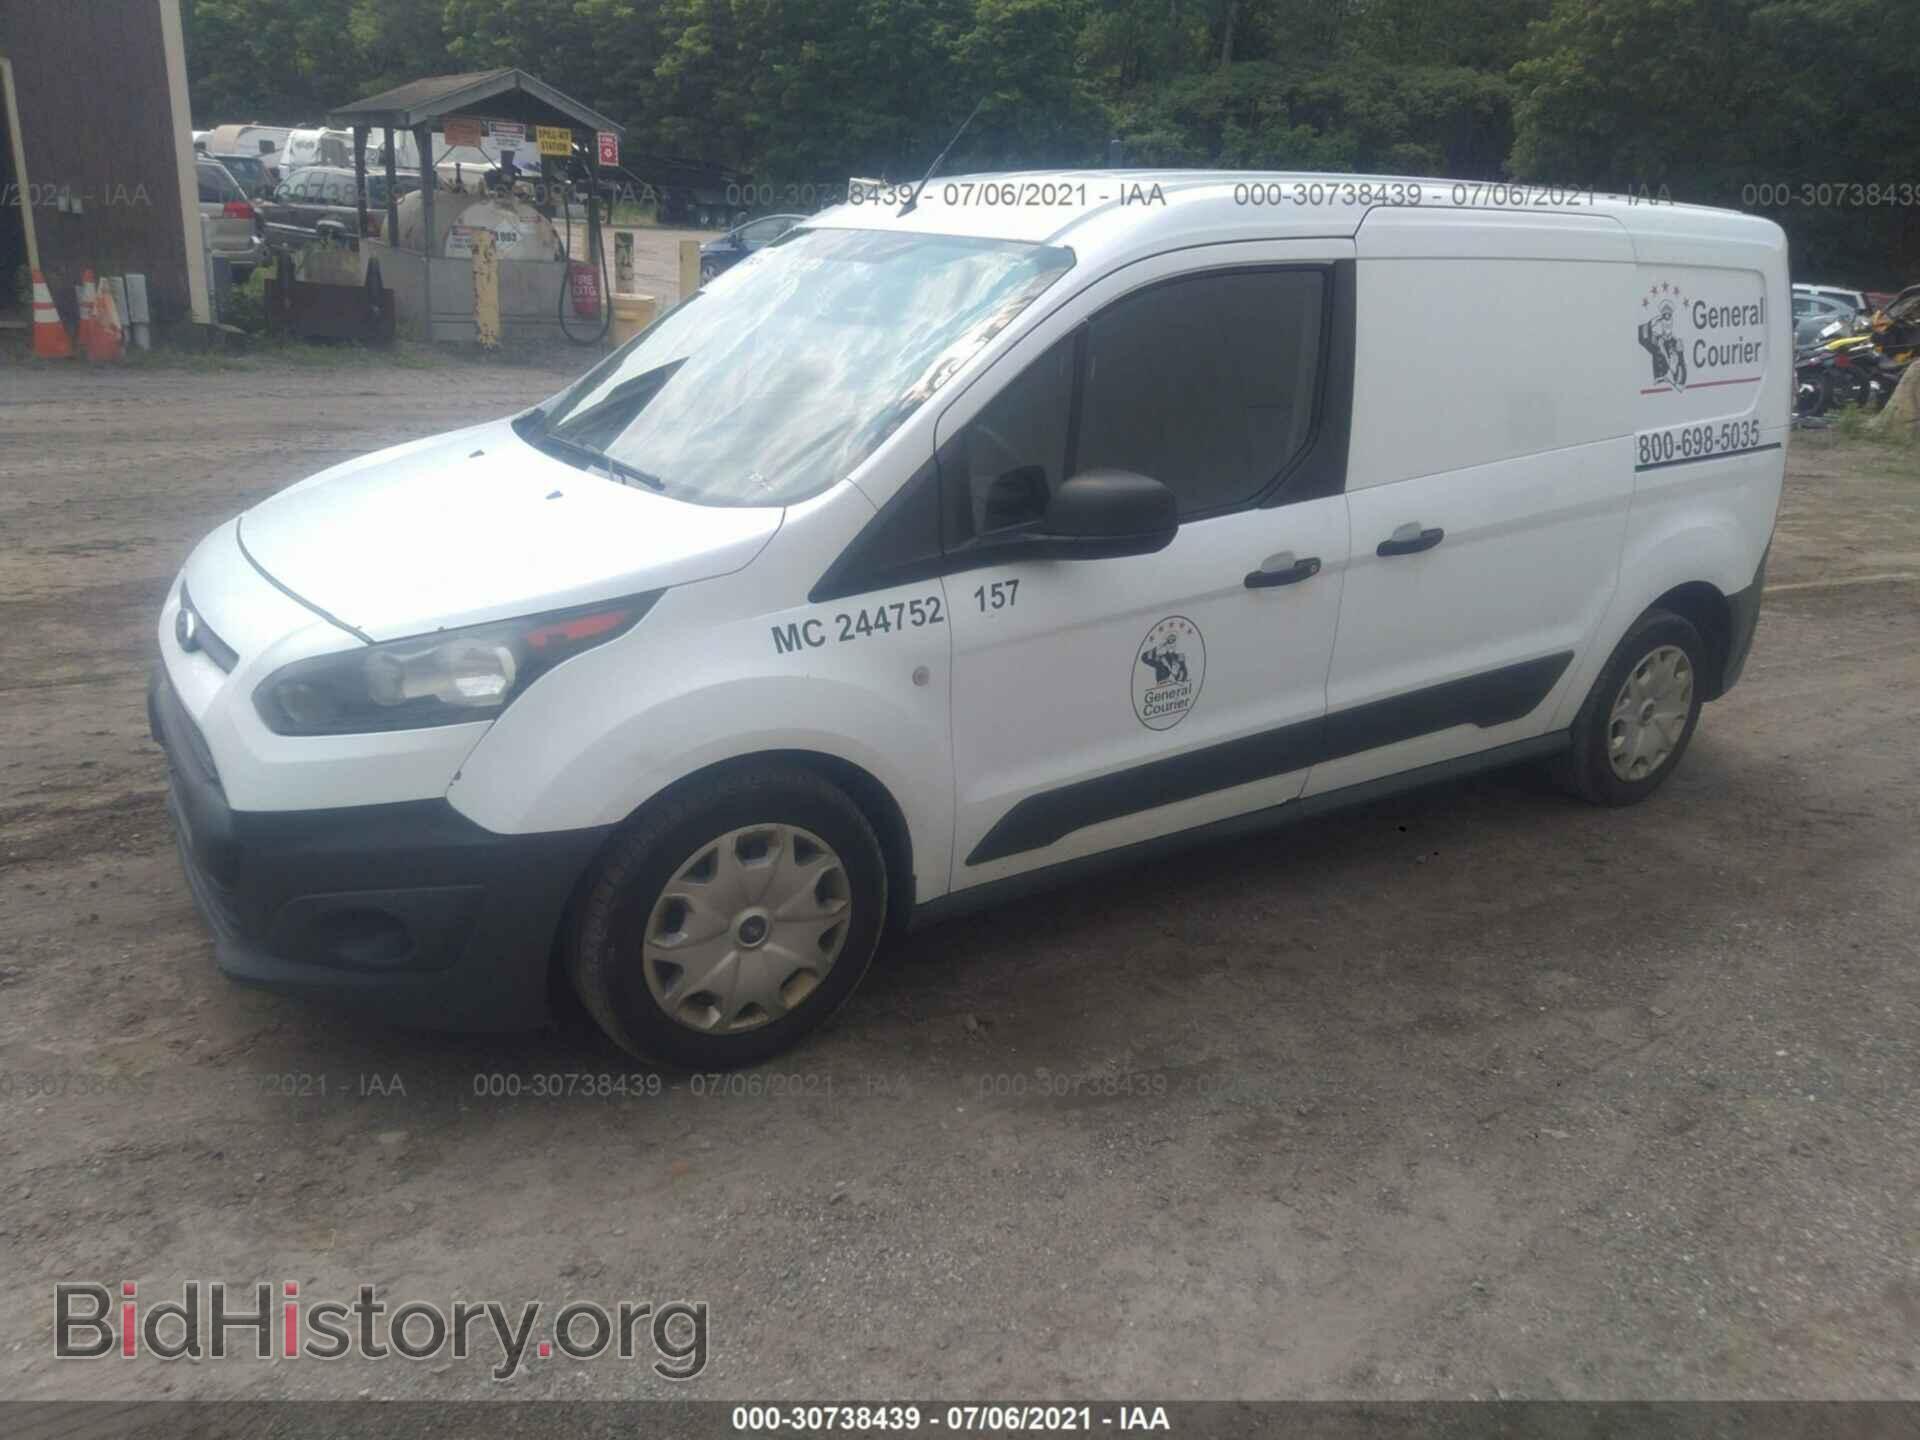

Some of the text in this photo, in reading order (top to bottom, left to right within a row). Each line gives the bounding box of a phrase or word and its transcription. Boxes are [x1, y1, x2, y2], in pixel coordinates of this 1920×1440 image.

[1692, 296, 1764, 330] General
[1693, 336, 1762, 368] Courier
[1638, 419, 1760, 463] 800-698-5035
[974, 579, 1019, 612] 157
[771, 596, 945, 654] MC 244752
[1143, 698, 1190, 717] Courier
[1144, 679, 1193, 705] General
